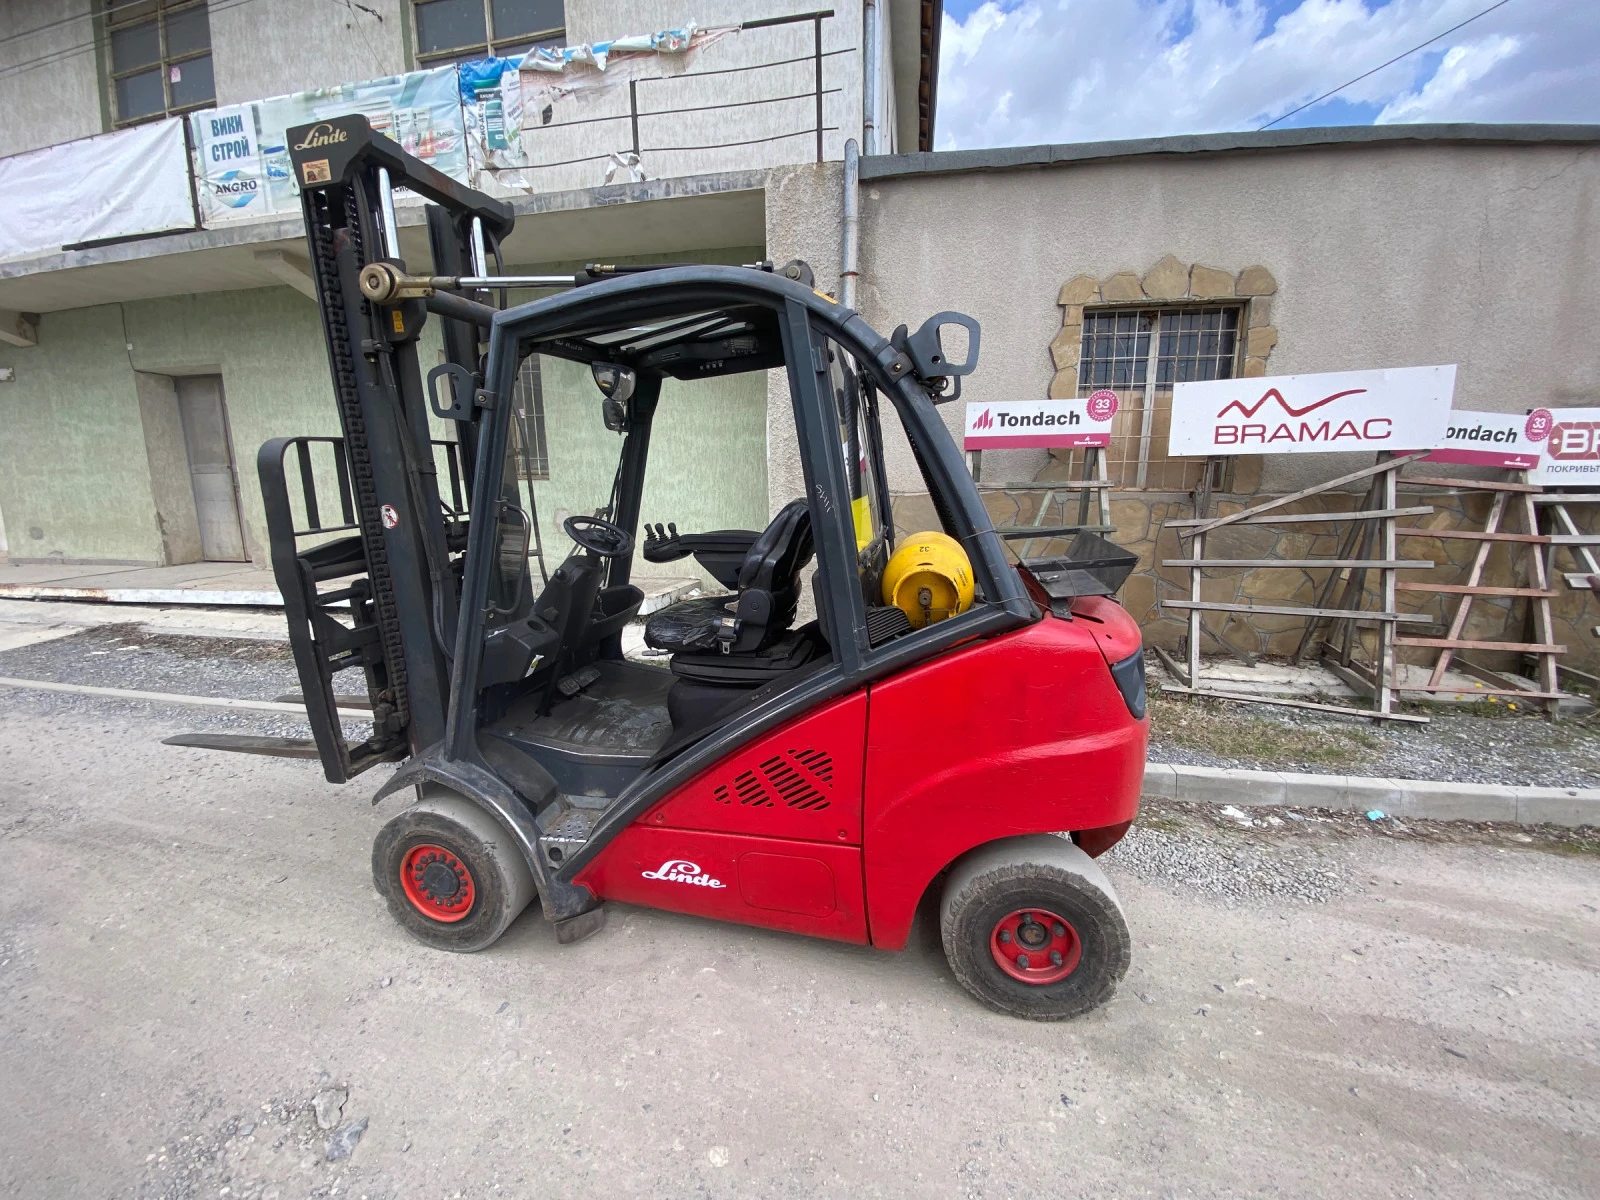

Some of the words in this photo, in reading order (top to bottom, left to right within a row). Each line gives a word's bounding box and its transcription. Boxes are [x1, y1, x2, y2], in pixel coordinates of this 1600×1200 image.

[210, 114, 243, 137] ВИКИ
[293, 123, 348, 151] Linde
[211, 136, 250, 162] СТРОЙ
[215, 180, 257, 195] ANGRO
[1095, 398, 1110, 409] 33
[997, 410, 1080, 427] Tondach
[1532, 417, 1546, 429] 33
[1214, 418, 1392, 445] BRAMAC
[1446, 424, 1518, 444] ondach
[641, 859, 726, 889] Linde
